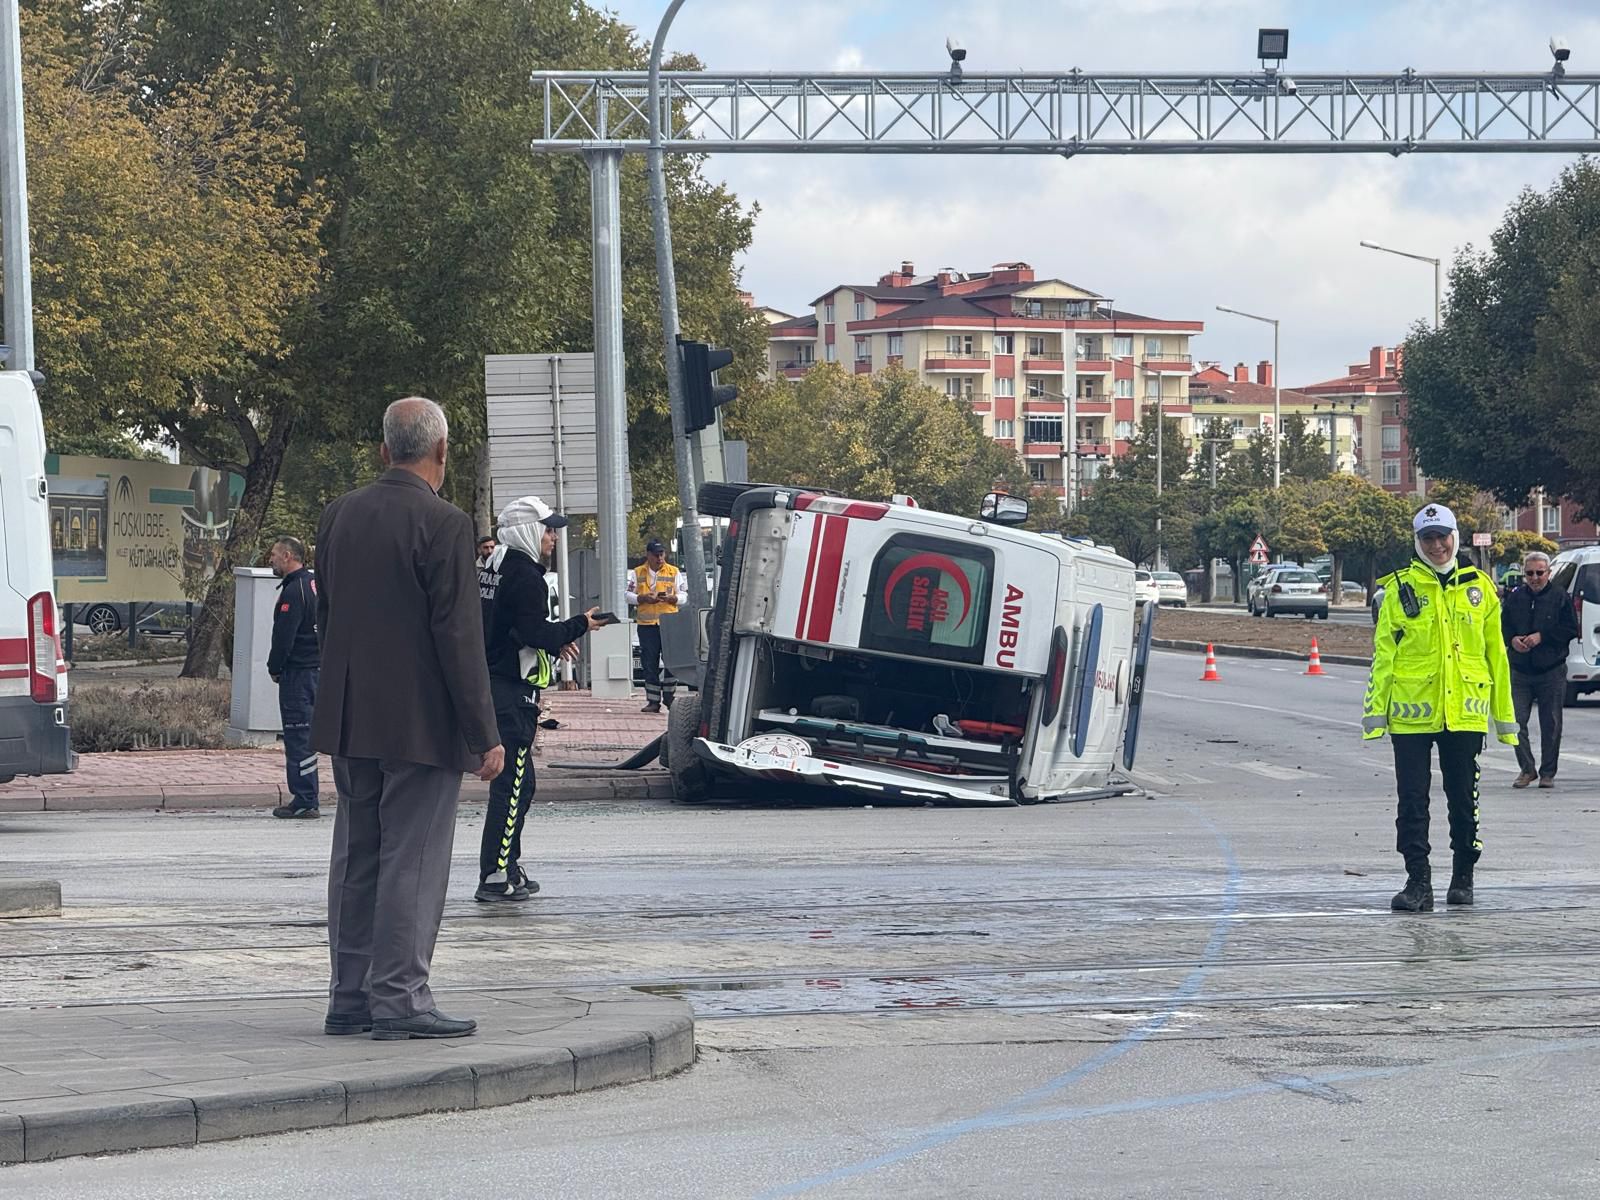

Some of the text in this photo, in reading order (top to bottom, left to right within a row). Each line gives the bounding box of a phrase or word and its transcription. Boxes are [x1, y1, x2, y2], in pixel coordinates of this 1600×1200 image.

[906, 576, 930, 631] SAĞLIK
[929, 587, 950, 622] ACİL
[996, 583, 1025, 669] AMBU
